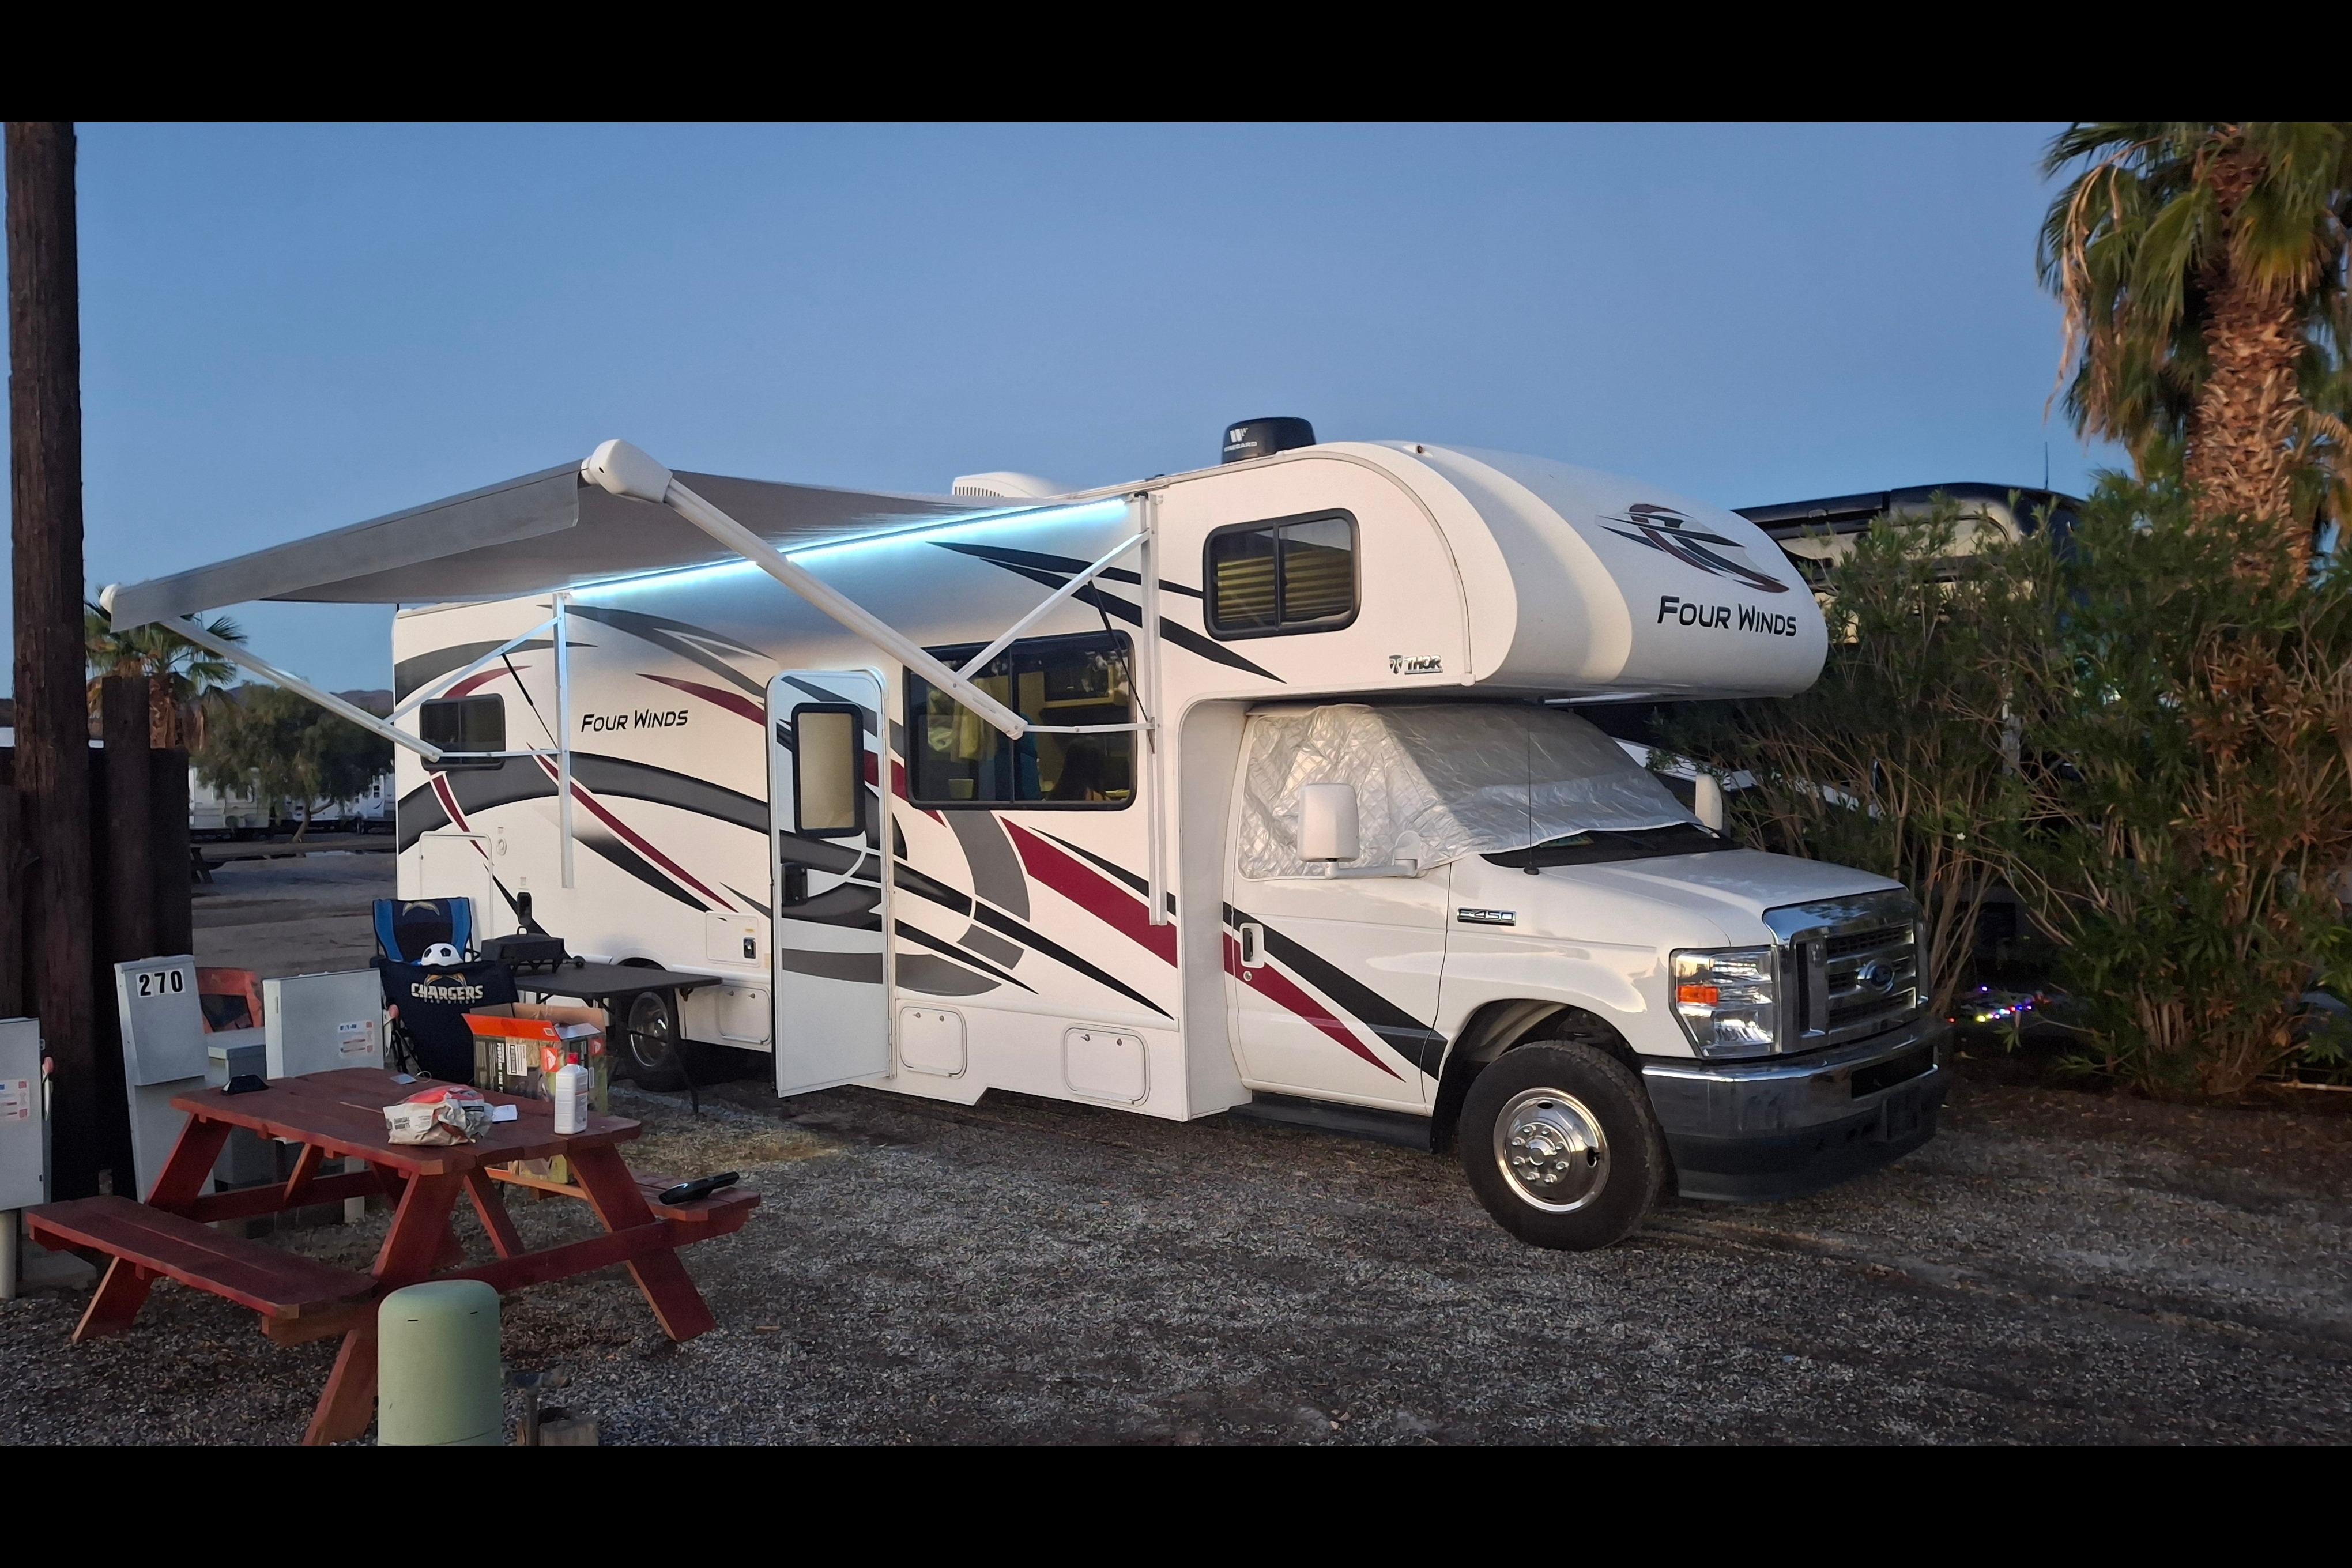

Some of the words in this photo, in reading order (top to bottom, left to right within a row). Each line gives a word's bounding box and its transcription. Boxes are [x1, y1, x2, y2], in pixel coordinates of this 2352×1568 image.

[1657, 595, 1731, 629] FOUR
[1738, 603, 1797, 636] WINDS
[1404, 655, 1442, 670] THOR
[581, 714, 628, 732] FOUR
[634, 709, 688, 729] WINDS
[139, 970, 183, 996] 270
[411, 983, 483, 1000] CHARGERS
